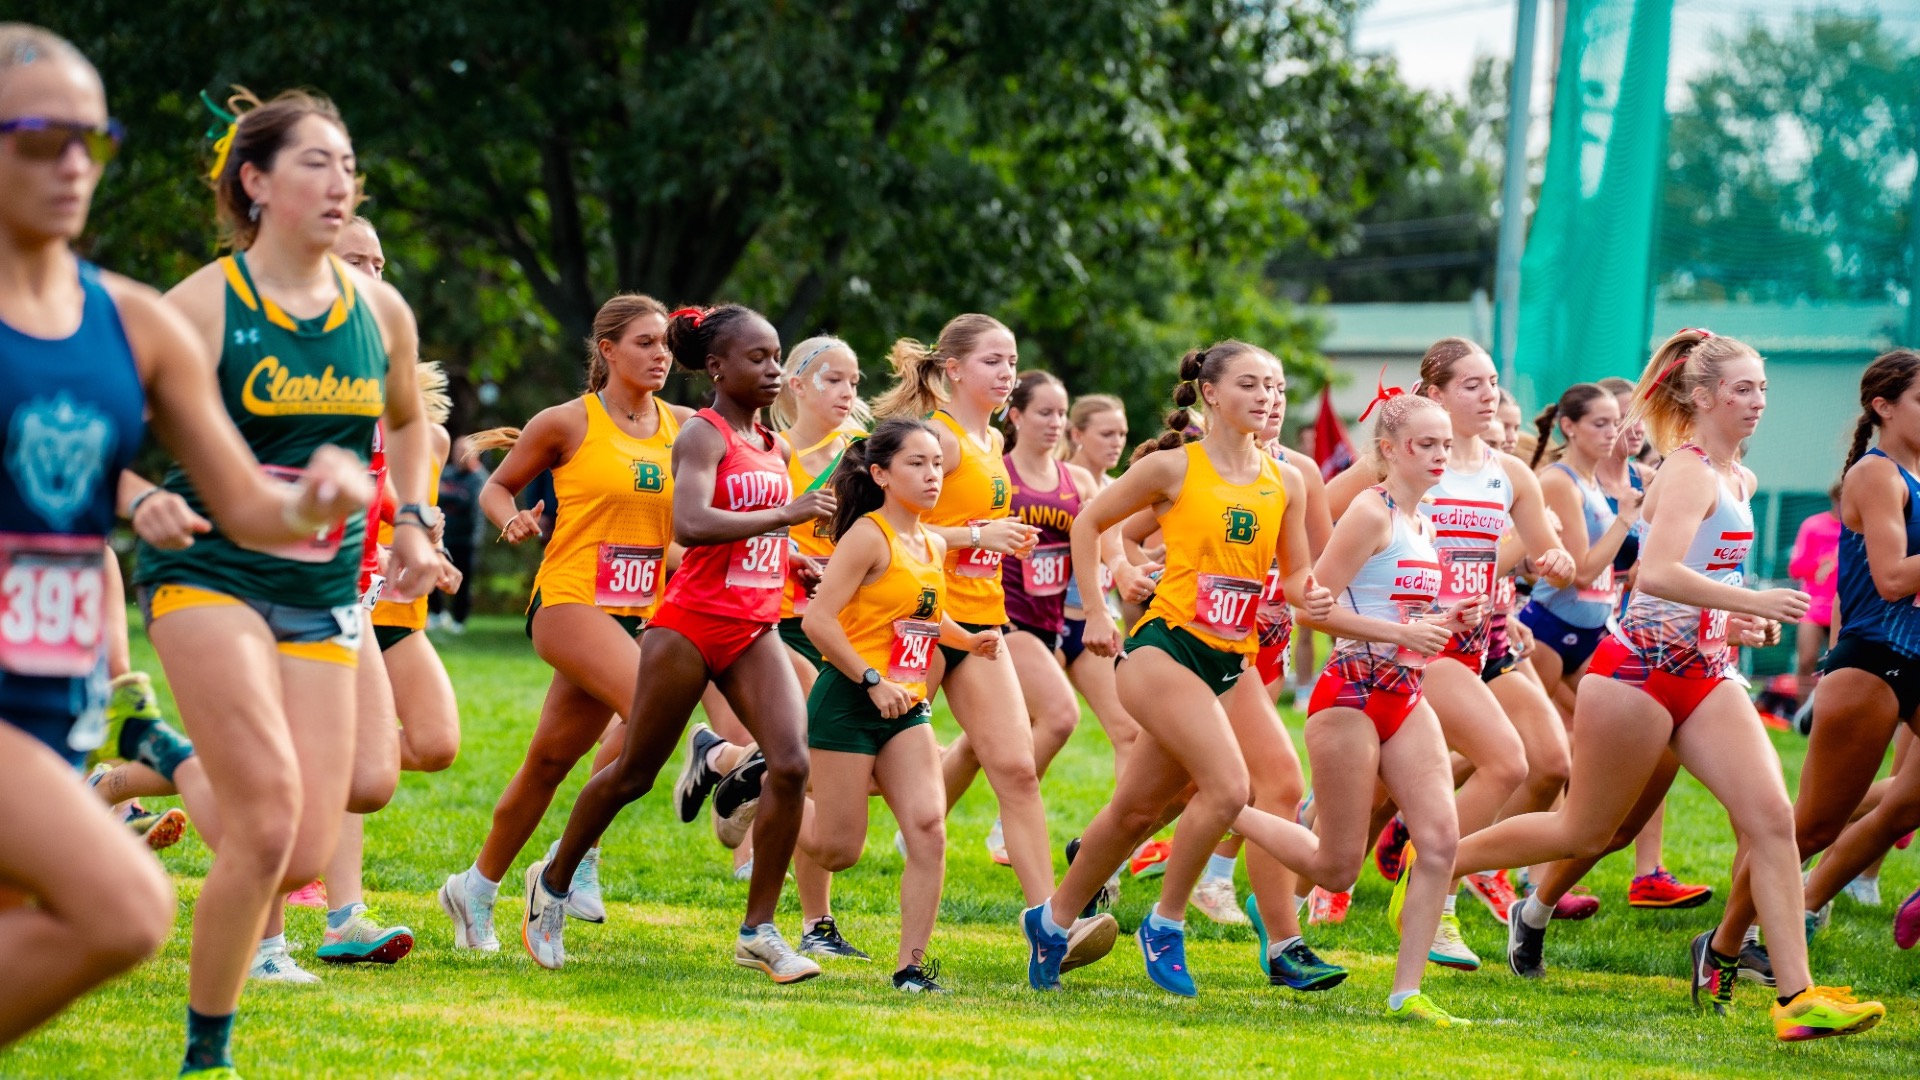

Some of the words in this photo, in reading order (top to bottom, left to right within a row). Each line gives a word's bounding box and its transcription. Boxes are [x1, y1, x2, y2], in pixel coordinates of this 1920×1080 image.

[242, 355, 384, 416] Clarkson
[1009, 504, 1075, 532] ANNO
[1225, 506, 1258, 545] B
[741, 537, 782, 573] 324
[1031, 555, 1064, 586] 381
[609, 559, 656, 593] 306
[1450, 561, 1489, 594] 356
[2, 564, 102, 646] 393
[1207, 589, 1252, 626] 307
[898, 634, 932, 669] 294
